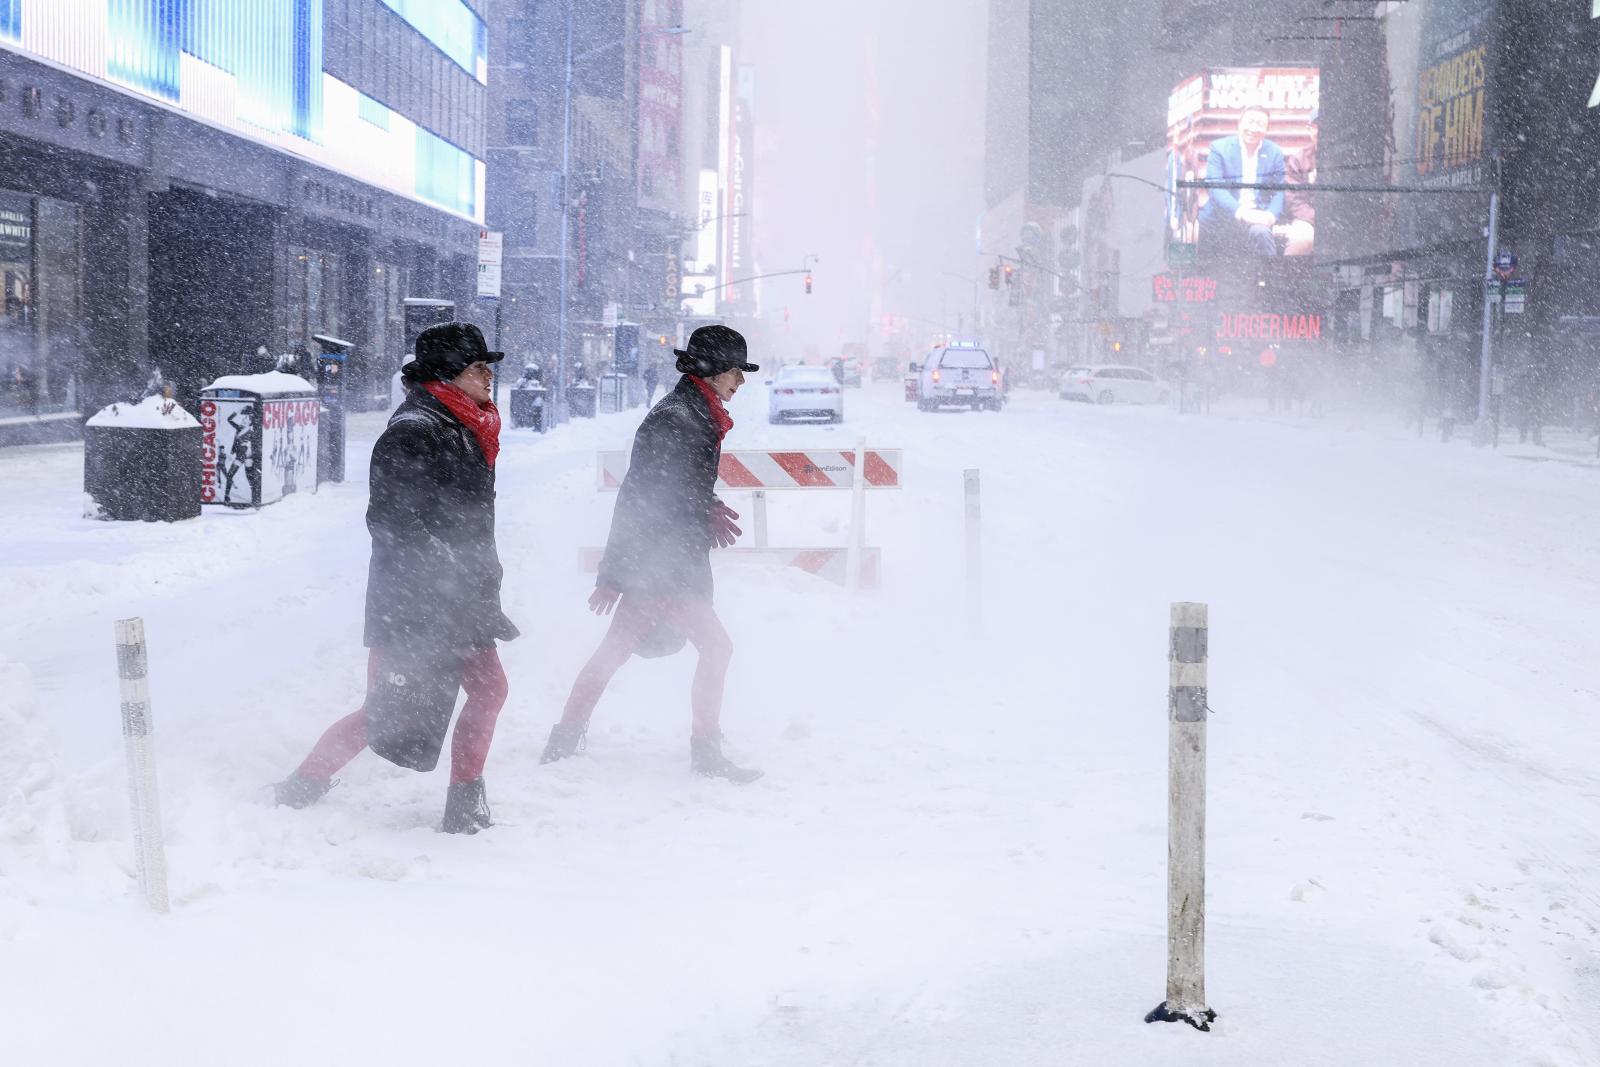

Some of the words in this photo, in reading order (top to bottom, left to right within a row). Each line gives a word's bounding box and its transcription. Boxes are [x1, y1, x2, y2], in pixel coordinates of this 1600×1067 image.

[1419, 44, 1486, 105] REMINDERS
[1416, 105, 1441, 176] OF
[1443, 87, 1484, 170] HIM
[199, 400, 217, 503] CHICAGO
[262, 400, 319, 430] CHICAGO
